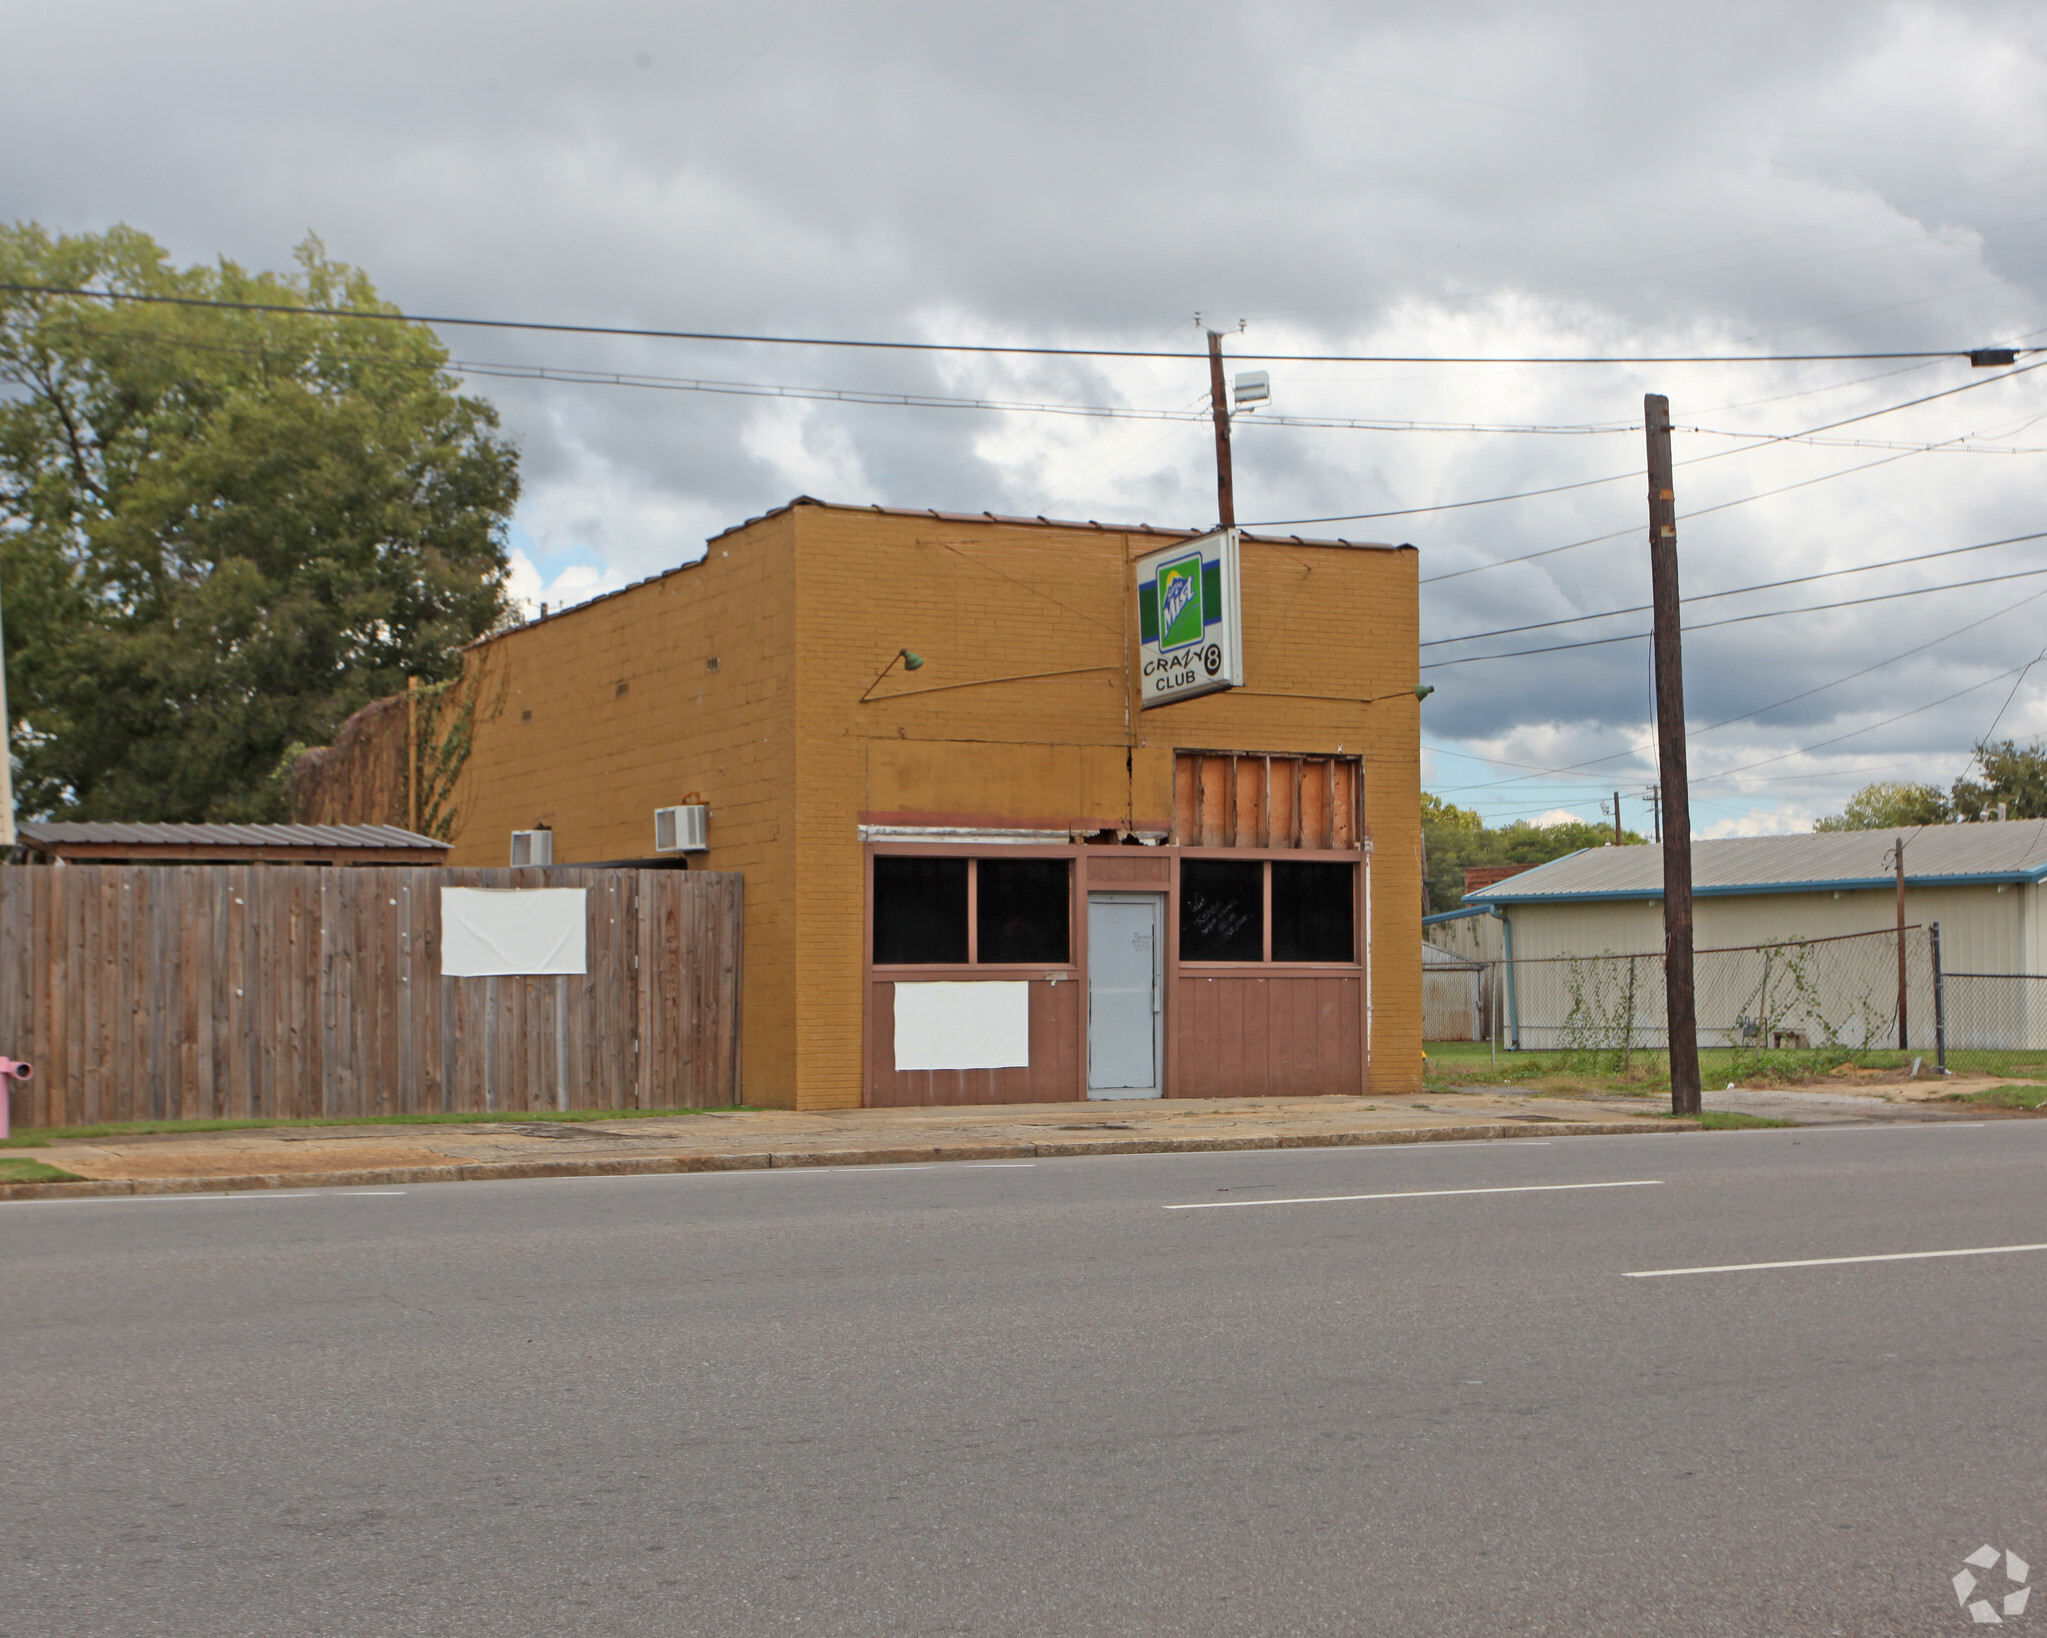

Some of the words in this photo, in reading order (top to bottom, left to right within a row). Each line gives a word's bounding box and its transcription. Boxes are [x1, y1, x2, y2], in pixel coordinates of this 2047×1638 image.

[1143, 646, 1205, 676] CRAZY
[1206, 645, 1220, 672] 8
[1156, 670, 1195, 691] CLUB
